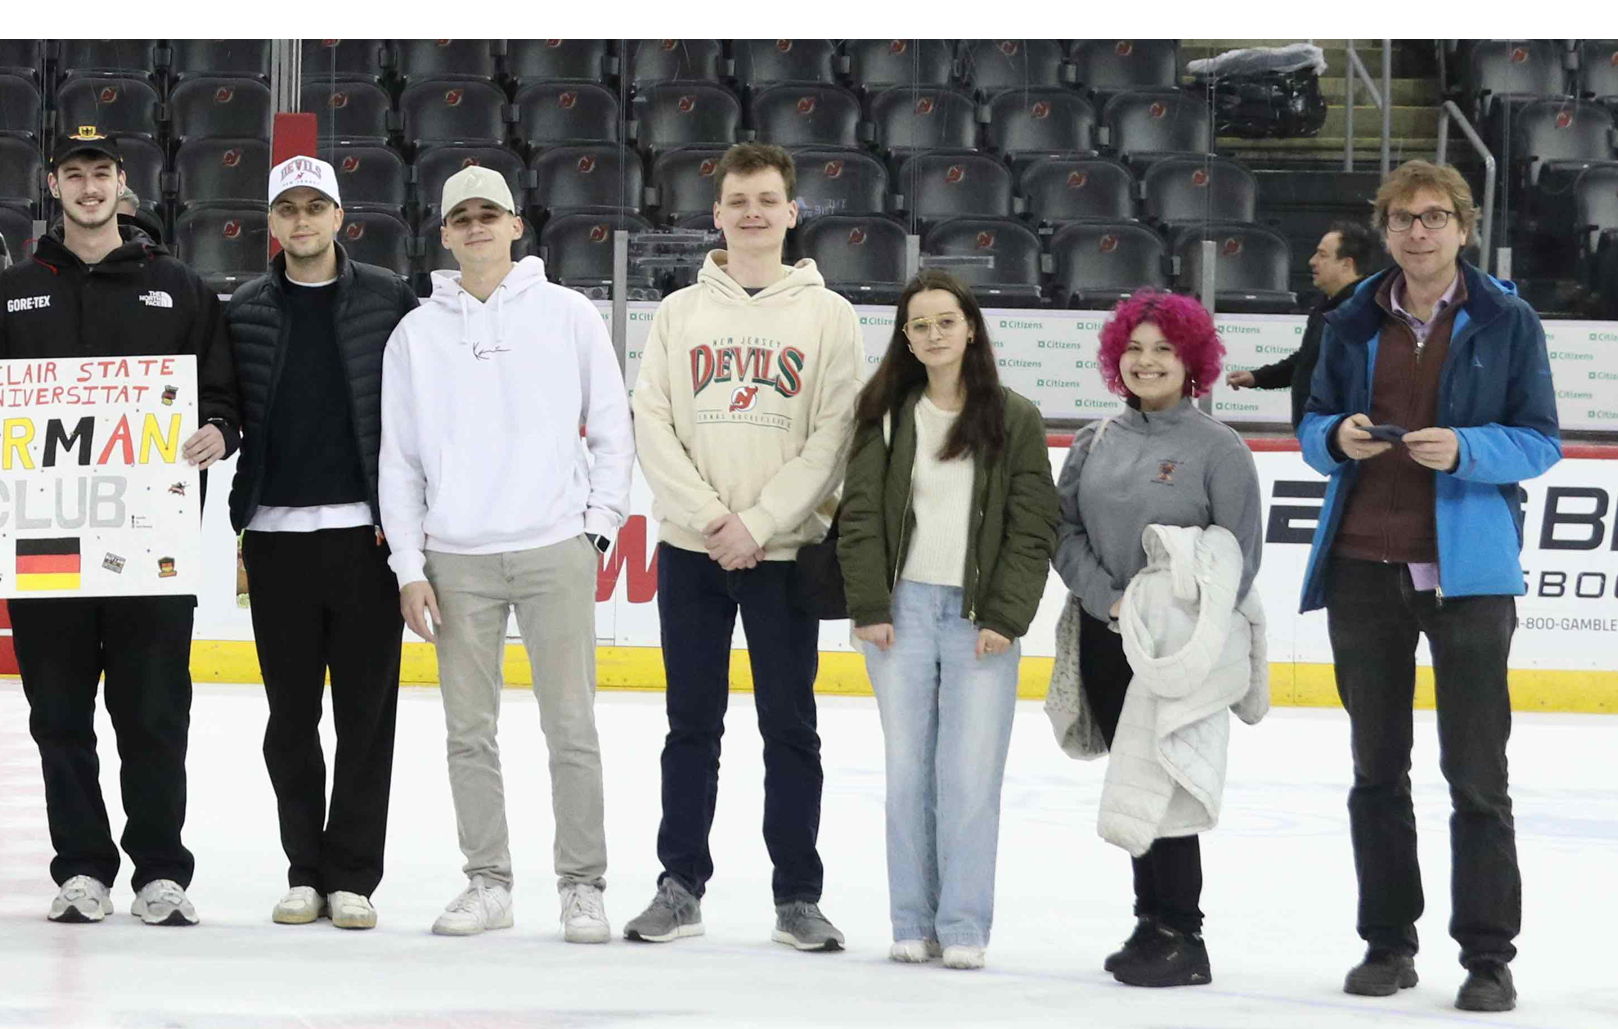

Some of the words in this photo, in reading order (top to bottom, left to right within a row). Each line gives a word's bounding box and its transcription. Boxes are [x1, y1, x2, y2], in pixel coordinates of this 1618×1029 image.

[280, 159, 322, 181] DEVILS
[7, 295, 51, 312] GORE-TEX
[1008, 320, 1043, 330] Citizens
[1225, 325, 1261, 334] Citizens
[740, 336, 781, 348] JERSEY
[1045, 340, 1081, 350] Citizens
[1559, 352, 1594, 360] Citizens
[1007, 359, 1042, 369] Citizens
[76, 358, 176, 382] STATE
[689, 344, 805, 398] DEVILS
[1044, 379, 1080, 389] Citizens
[1558, 391, 1592, 399] Citizens
[1081, 399, 1118, 409] Citizens
[1224, 402, 1259, 411] Citizens
